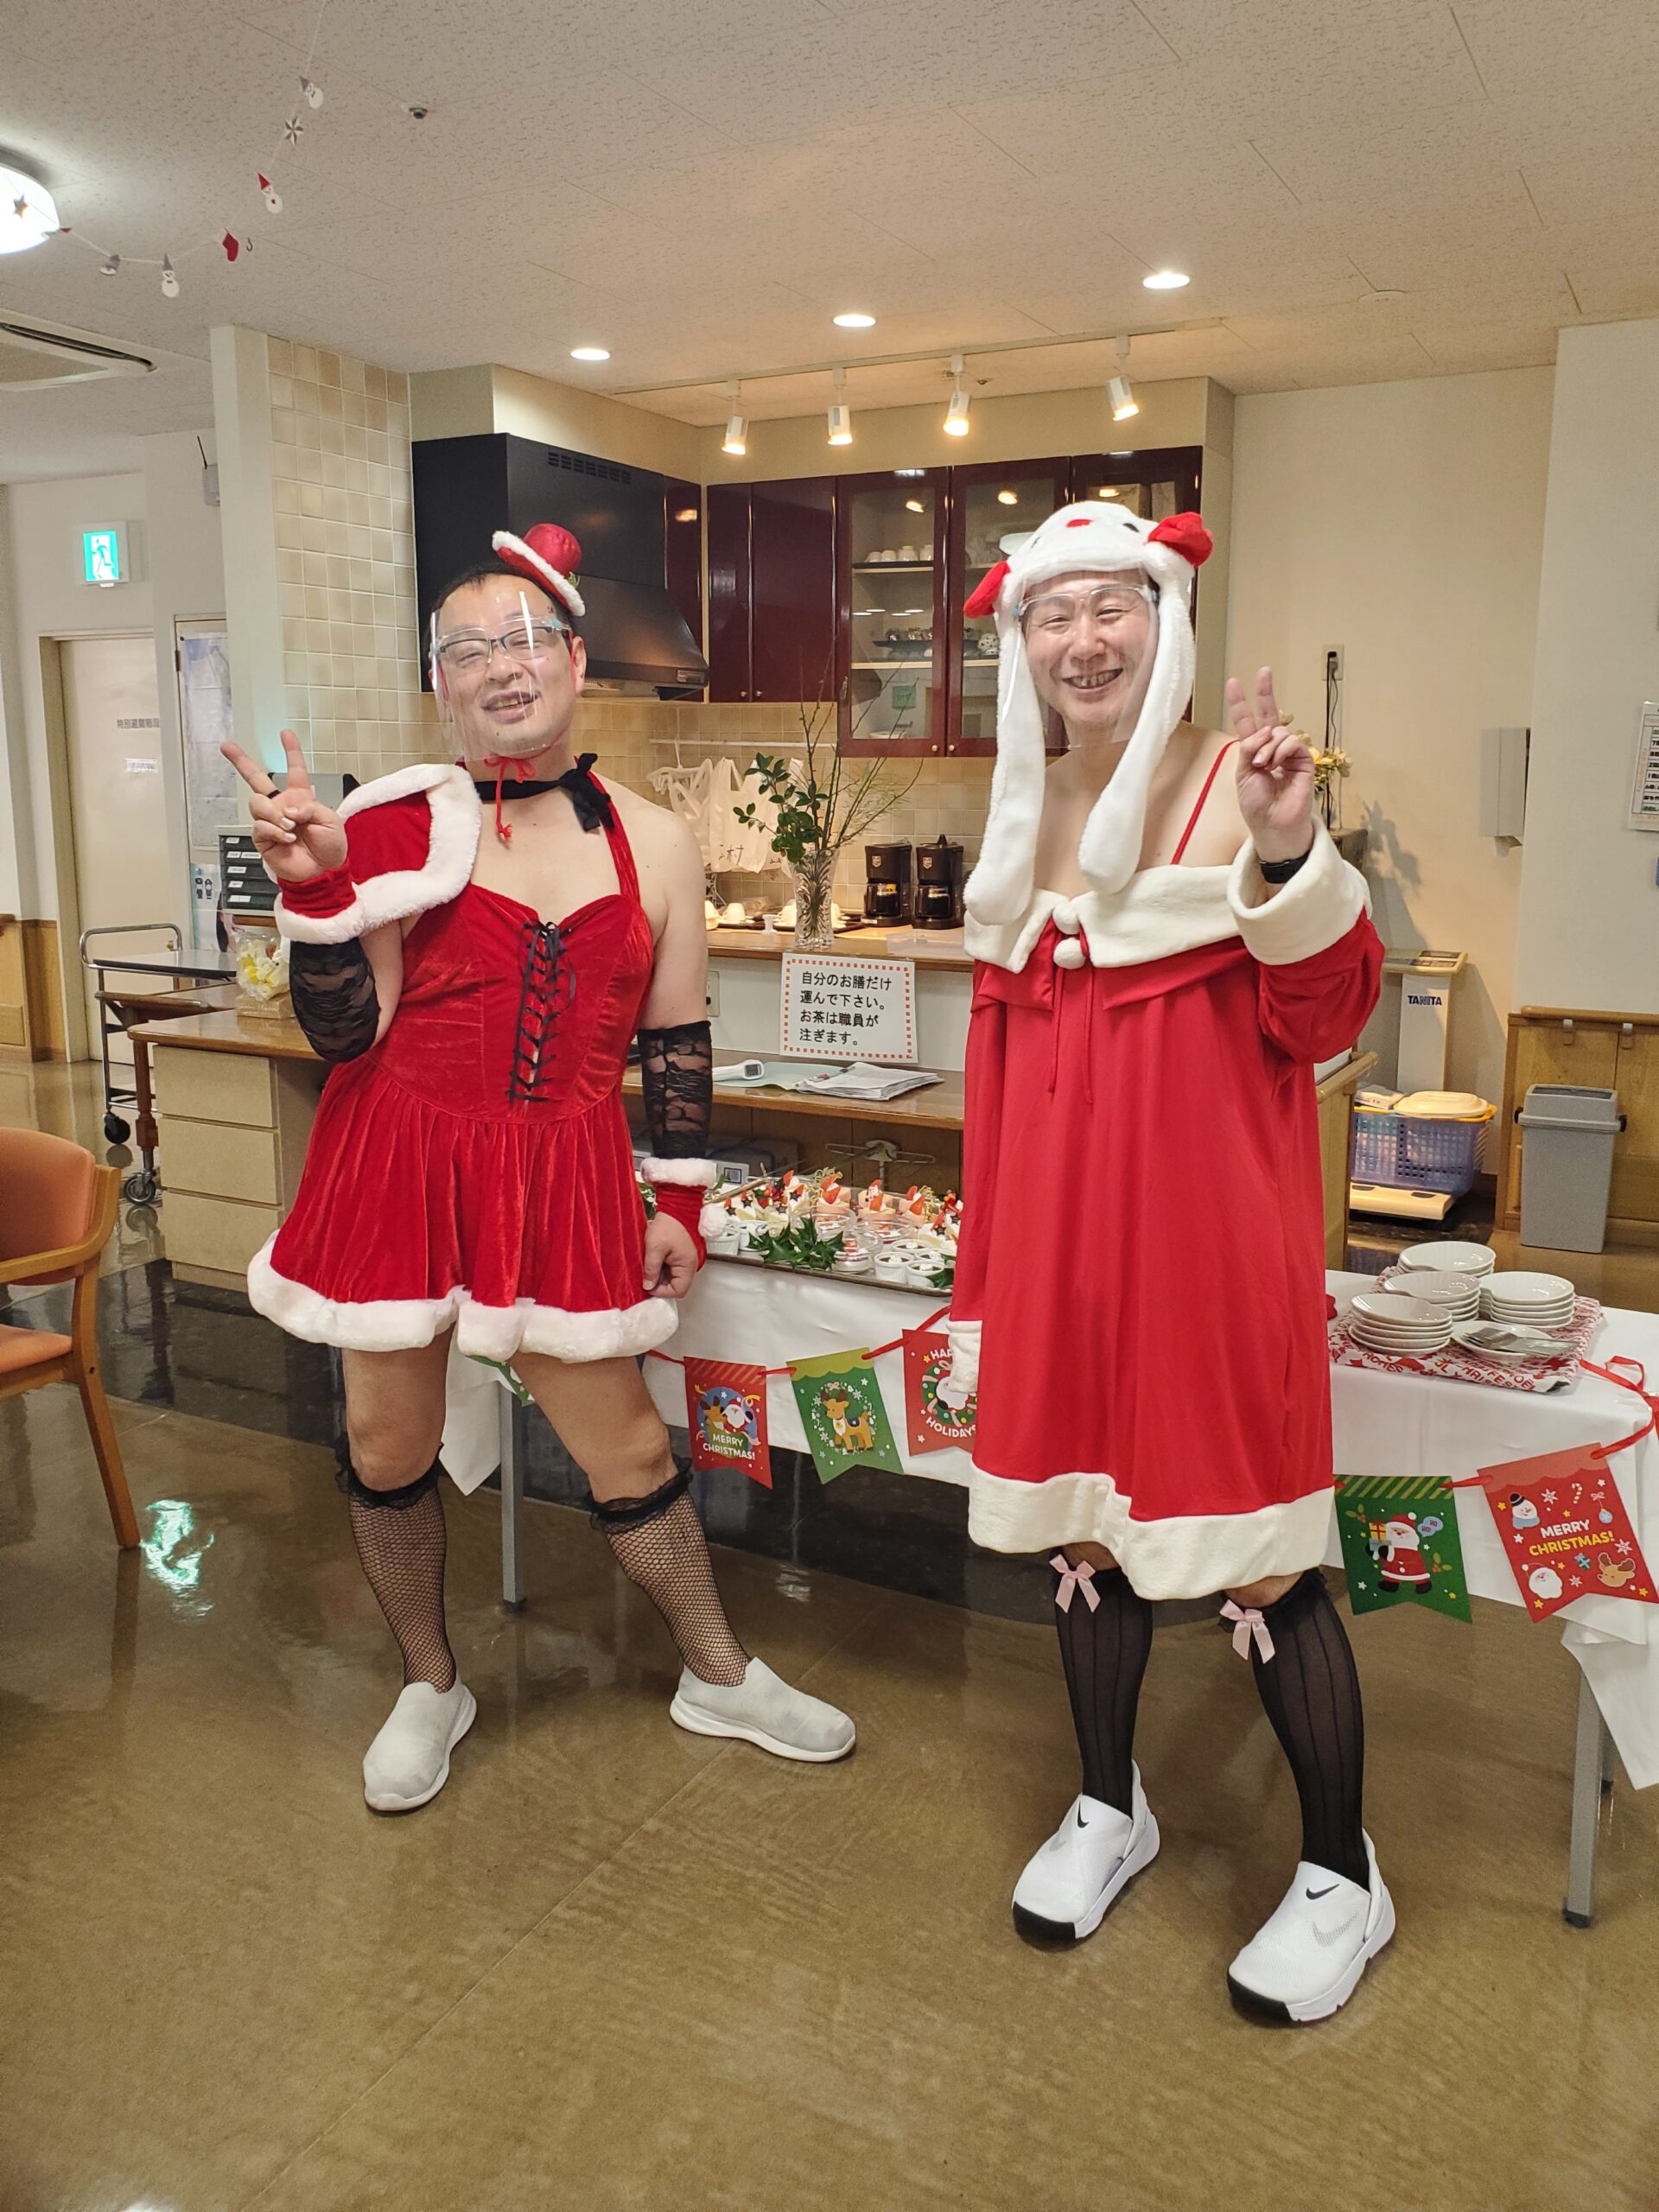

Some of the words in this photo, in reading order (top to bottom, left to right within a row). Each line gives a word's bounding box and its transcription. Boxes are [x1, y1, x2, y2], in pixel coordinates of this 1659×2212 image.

[802, 971, 892, 991] 自分のお膳だけ
[800, 990, 884, 1010] 運んで下さい。
[1408, 995, 1442, 1005] TANITA
[800, 1009, 879, 1027] お茶は職員が
[799, 1028, 858, 1046] 注ぎます。
[930, 1349, 952, 1360] HAP
[713, 1433, 743, 1446] MERRY
[702, 1443, 755, 1460] CHRISTMAS!
[1541, 1519, 1590, 1538] MERRY
[1529, 1530, 1615, 1556] CHRISTMAS!
